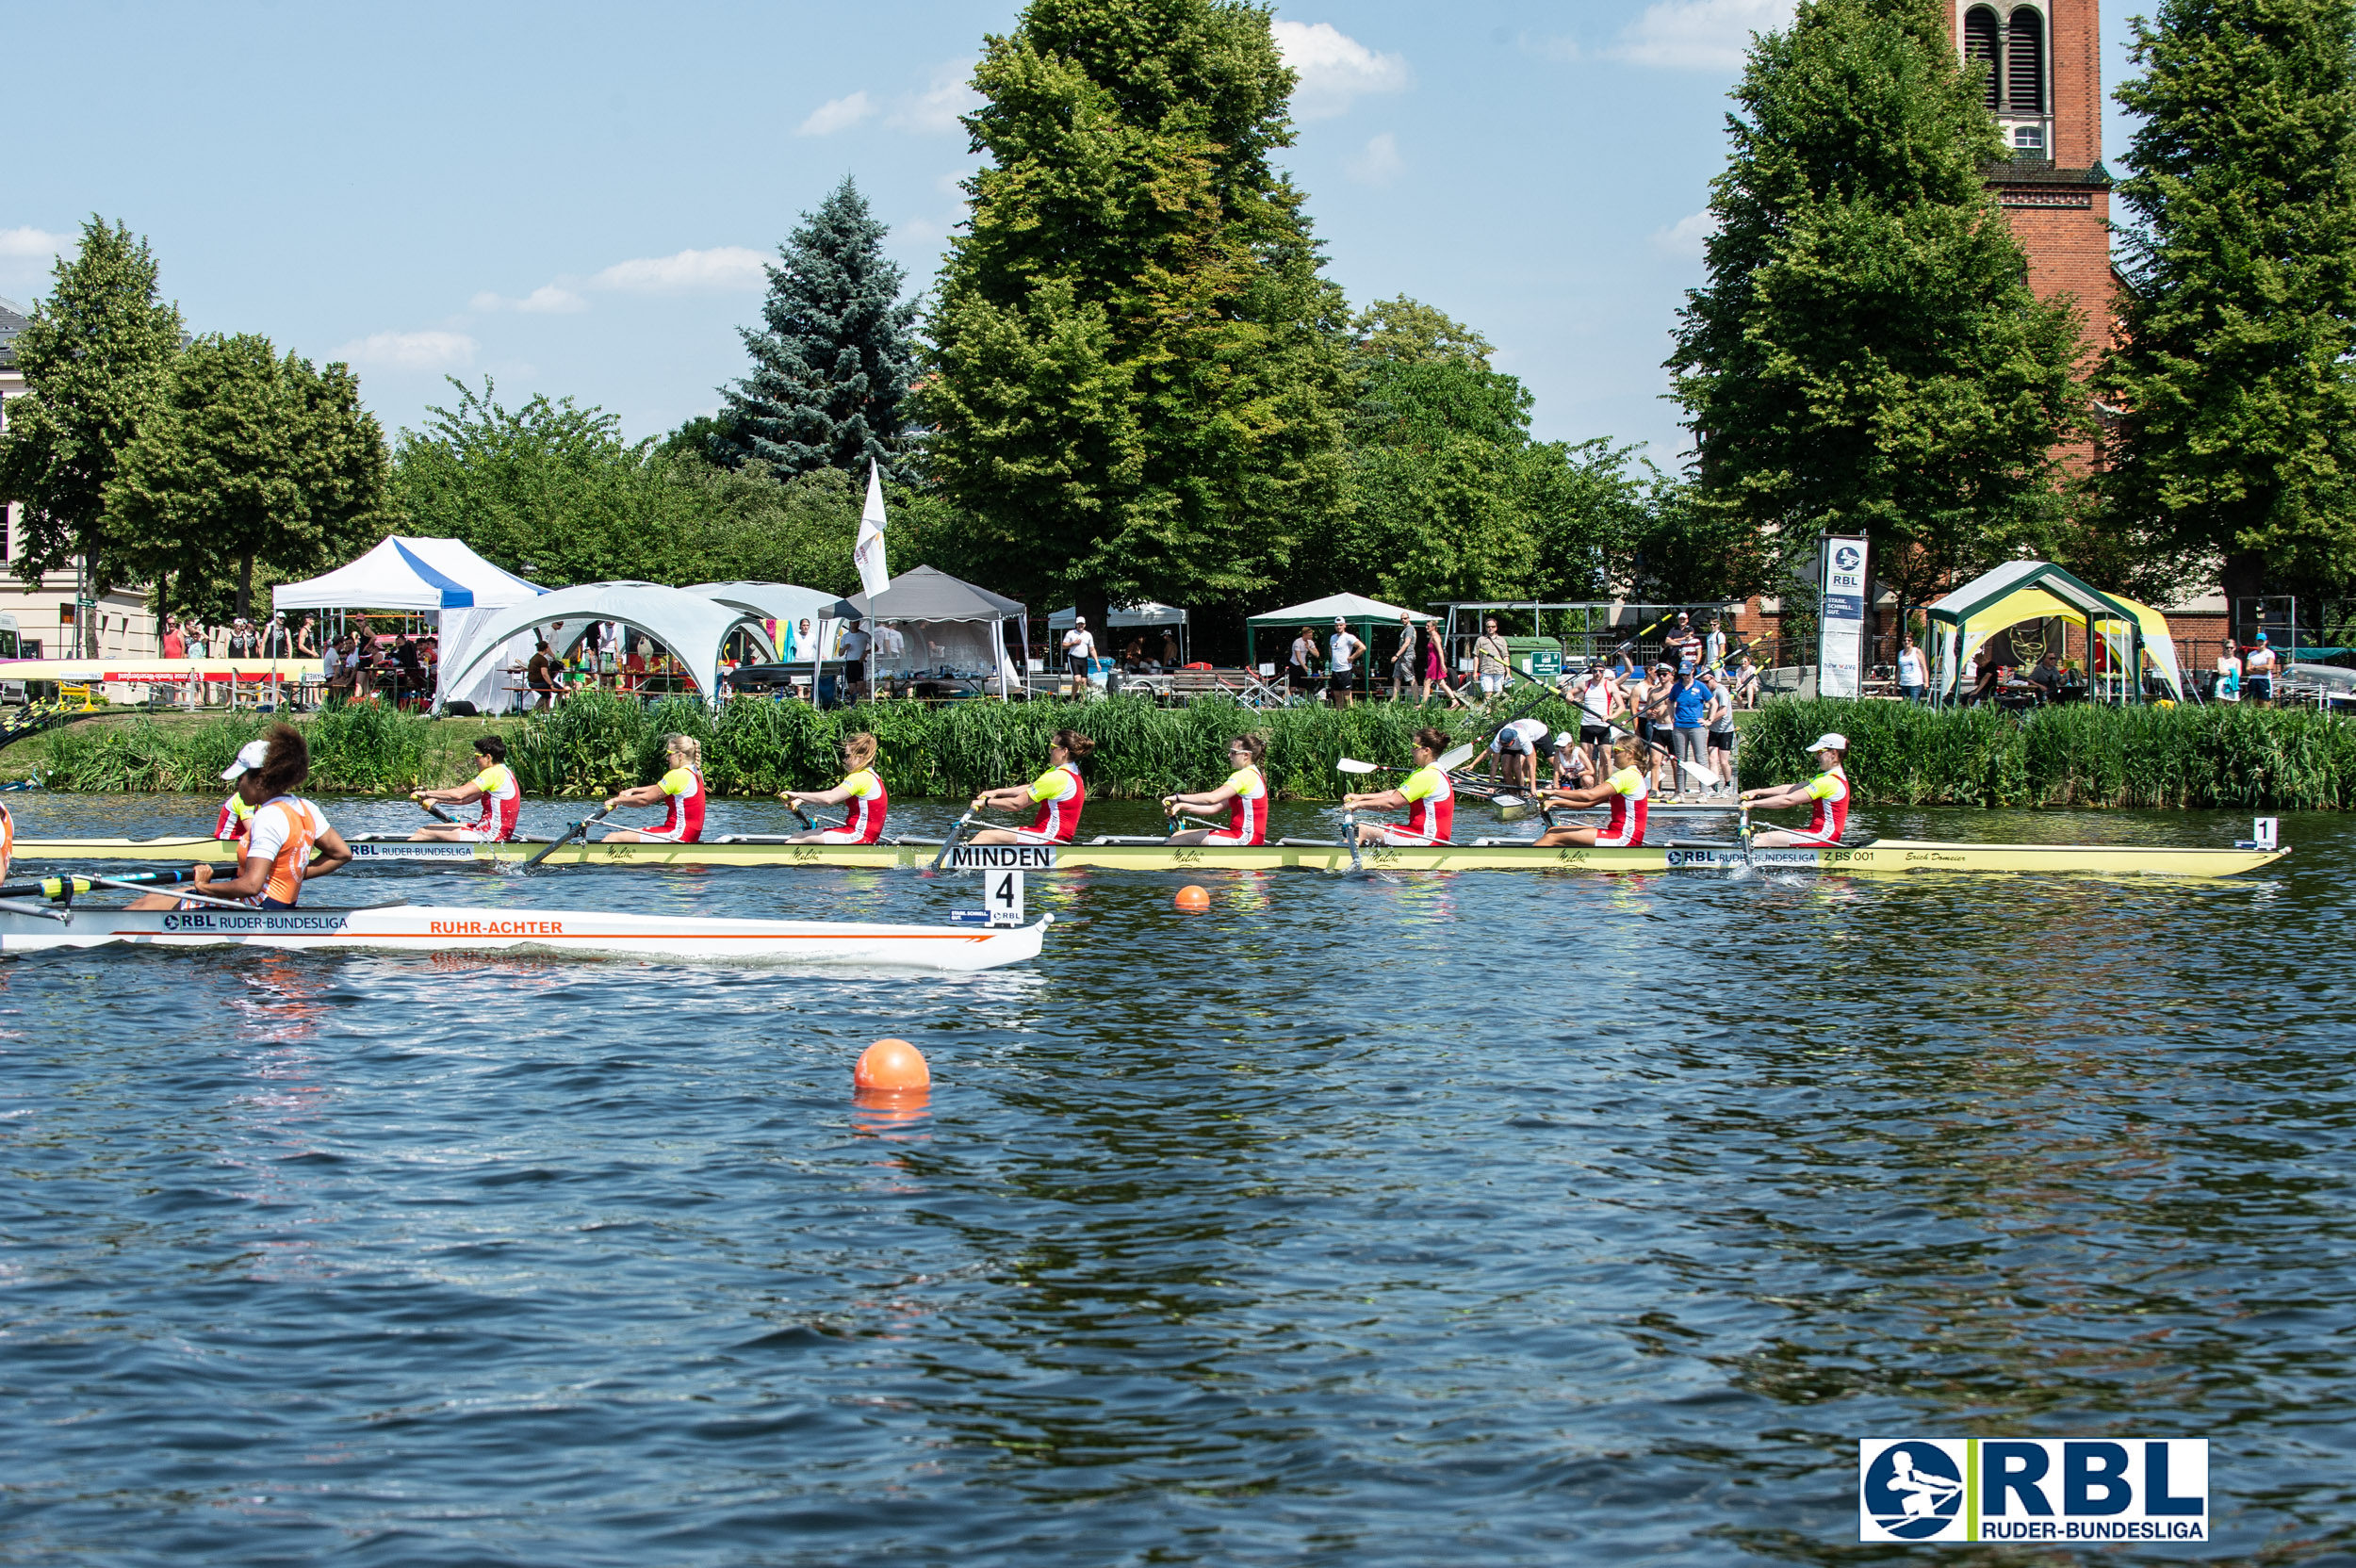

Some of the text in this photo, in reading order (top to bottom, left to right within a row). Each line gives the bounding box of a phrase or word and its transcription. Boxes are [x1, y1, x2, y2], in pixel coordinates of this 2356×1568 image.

[1833, 576, 1857, 585] RBL
[173, 673, 198, 681] Skasse
[2258, 821, 2266, 839] 1
[350, 844, 472, 857] RBL RUDER-BUNDESLIGA
[952, 847, 1051, 867] MINDEN
[1683, 851, 1816, 862] RBL RUDE-BUNDESLIGA
[1824, 852, 1874, 861] Z BS 001
[1905, 852, 1929, 861] Erich
[995, 872, 1015, 908] 4
[182, 915, 349, 929] RBL RUDER-BUNDESLIGA
[430, 921, 564, 934] RUHR-ACHTER
